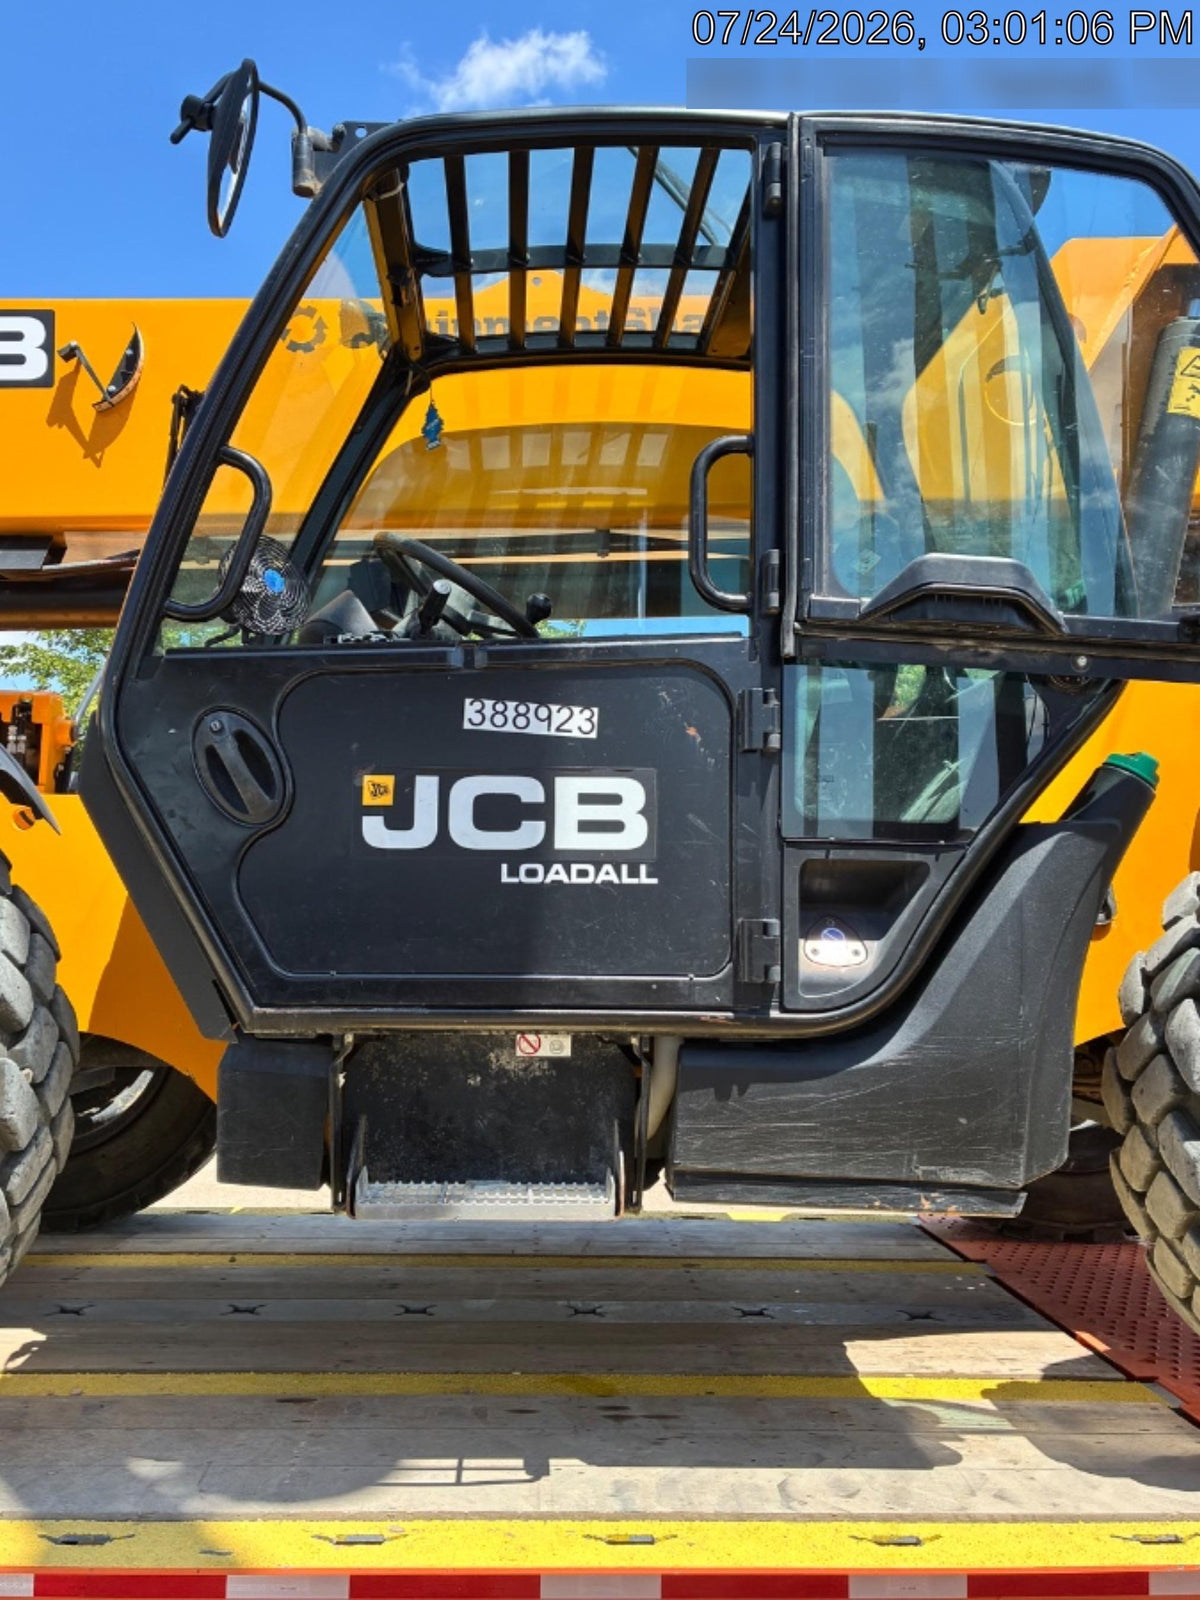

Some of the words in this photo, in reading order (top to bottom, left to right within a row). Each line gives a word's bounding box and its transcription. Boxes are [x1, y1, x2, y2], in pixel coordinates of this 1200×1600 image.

[467, 698, 597, 736] 388923
[362, 775, 649, 850] JCB
[501, 863, 658, 884] LOADALL
